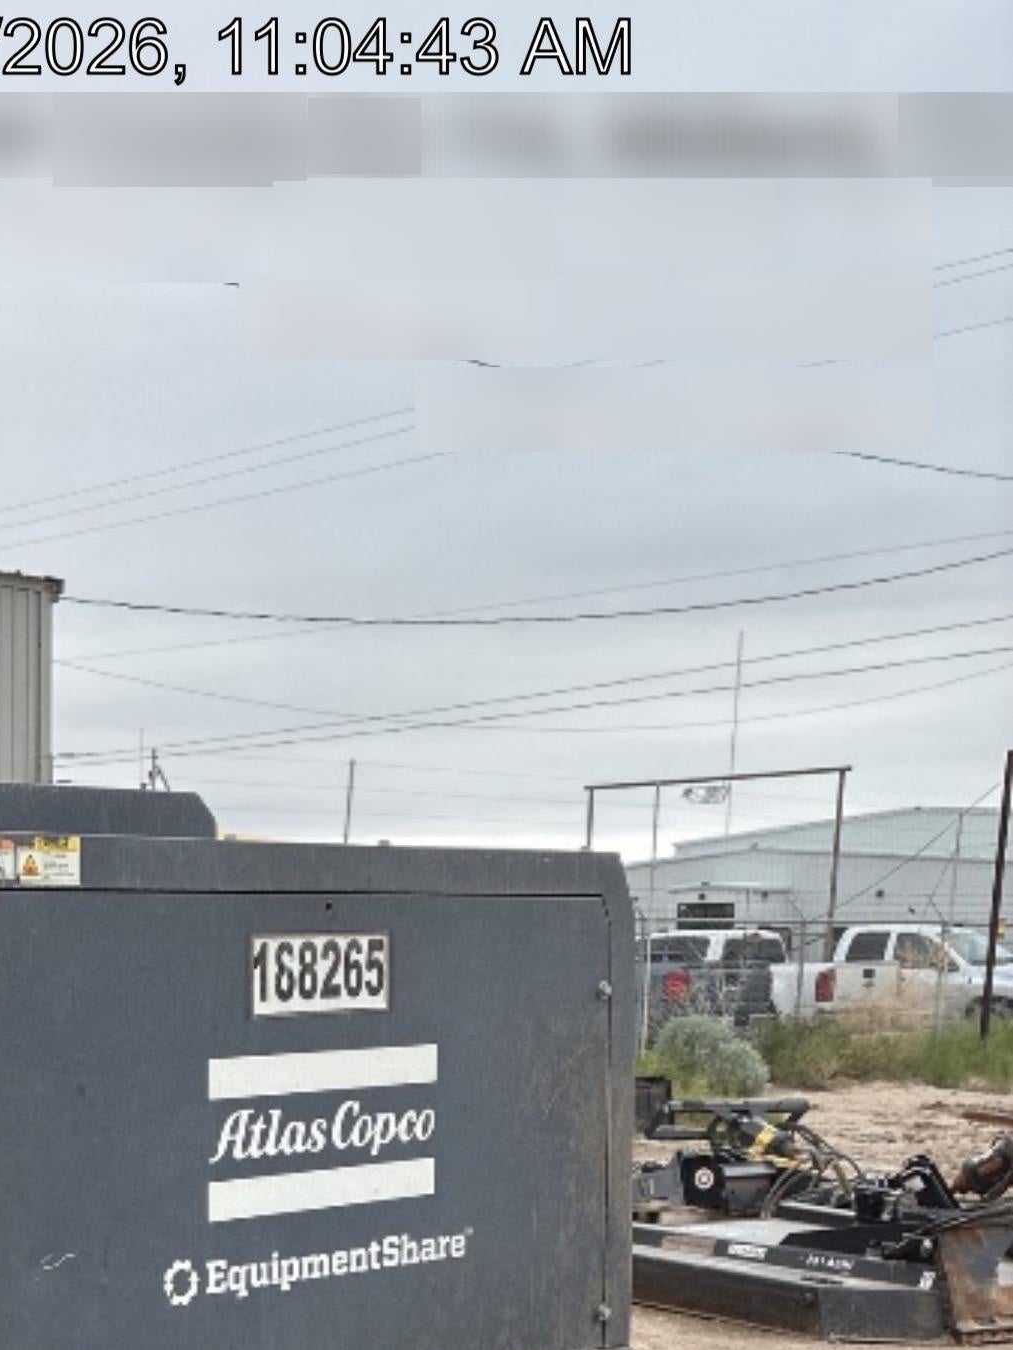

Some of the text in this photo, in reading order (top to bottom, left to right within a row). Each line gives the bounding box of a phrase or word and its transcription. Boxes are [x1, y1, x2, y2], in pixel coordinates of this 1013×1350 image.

[253, 938, 384, 1002] 188265
[209, 1100, 436, 1163] Atlas Copco
[205, 1234, 466, 1298] EquipmentShare
